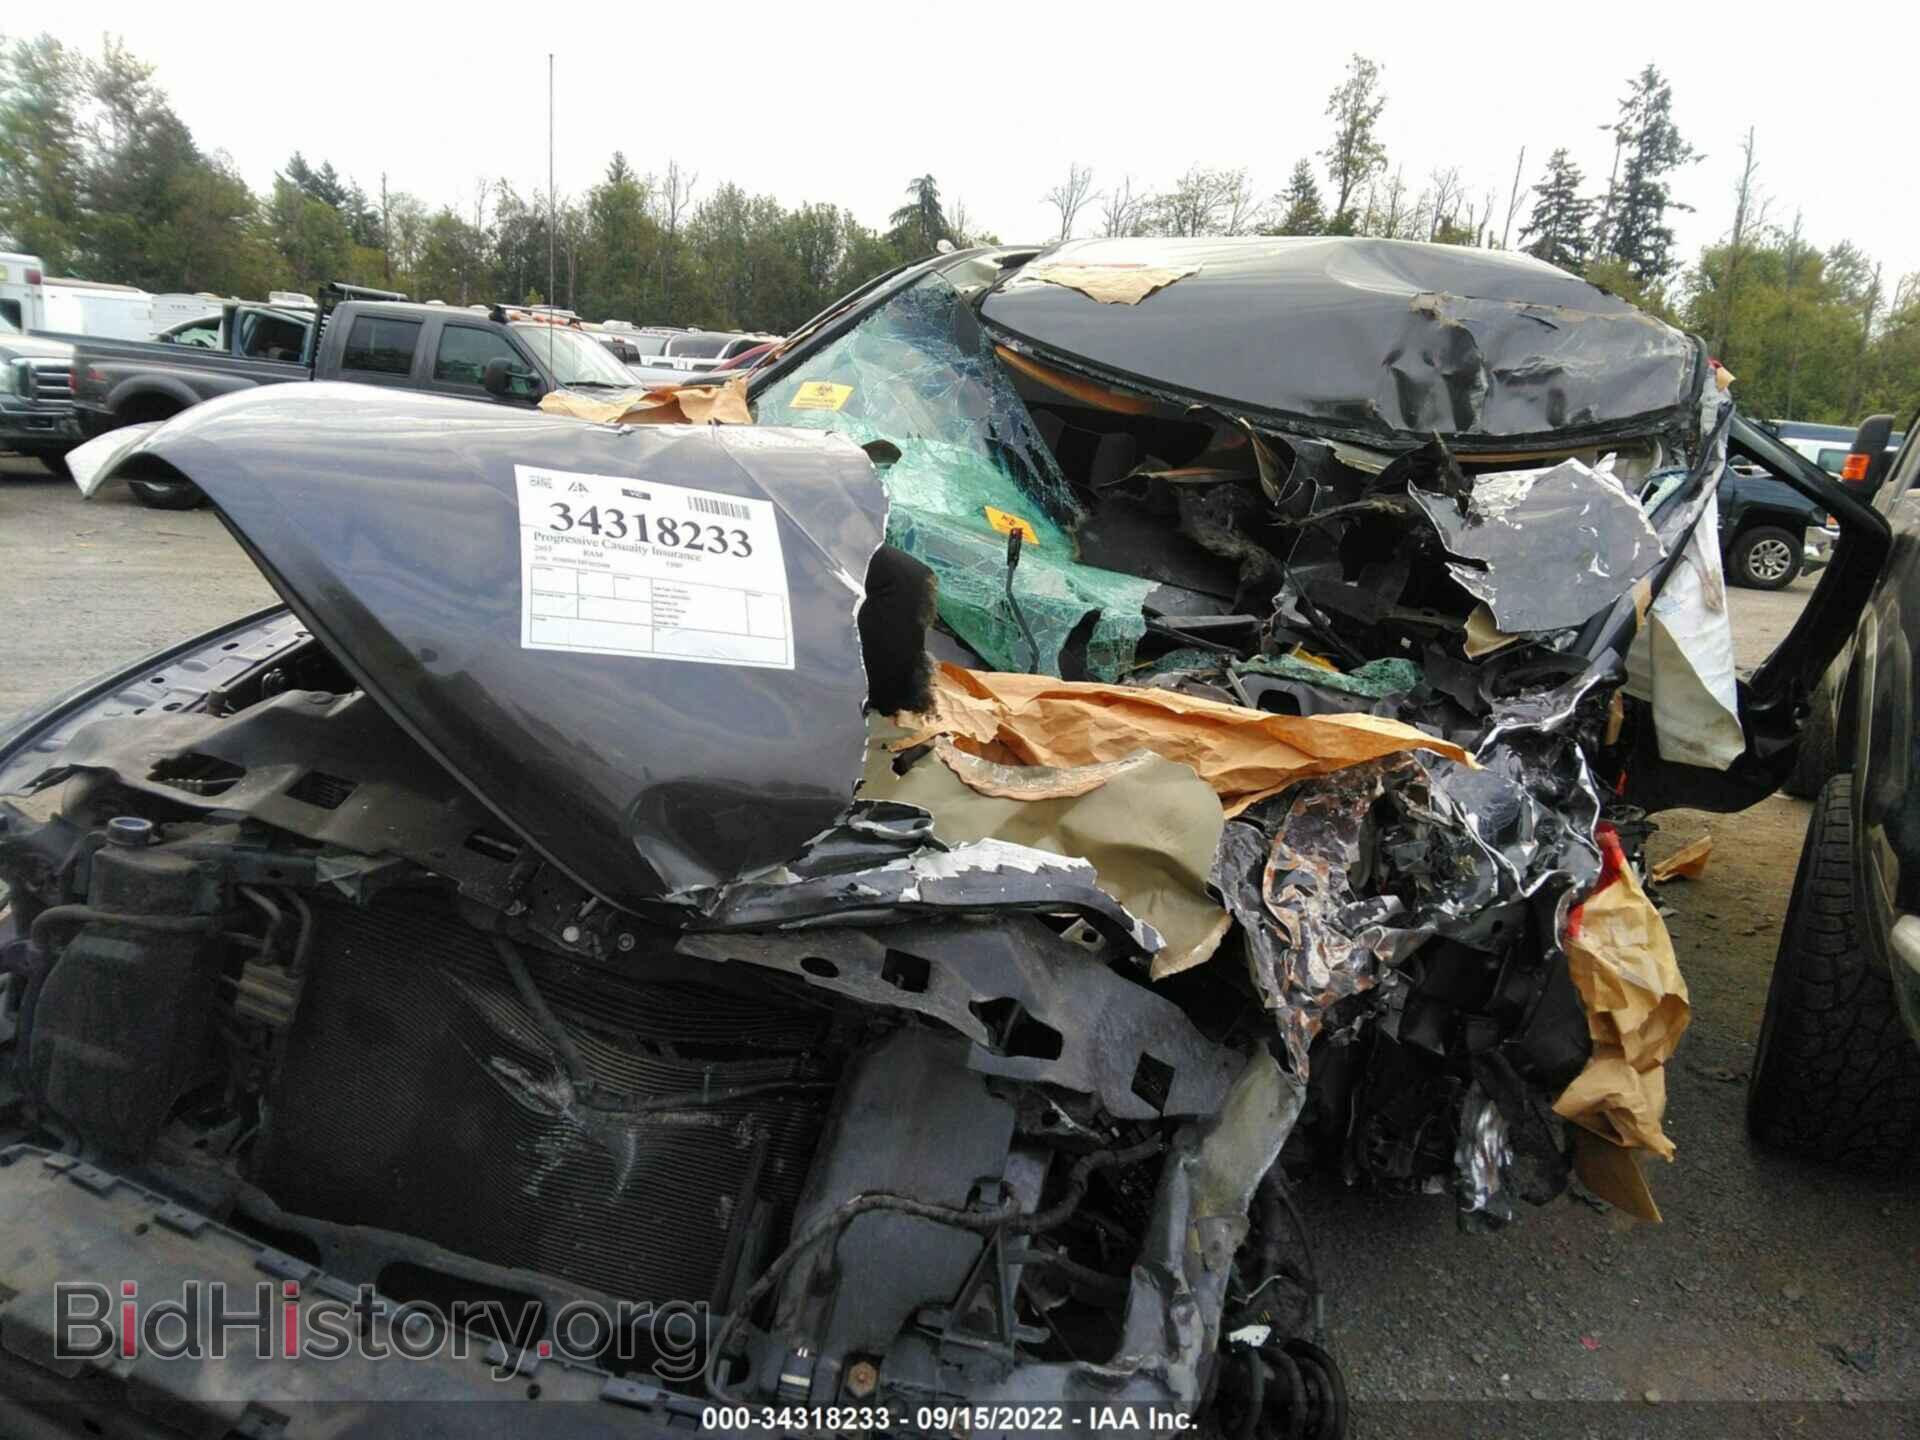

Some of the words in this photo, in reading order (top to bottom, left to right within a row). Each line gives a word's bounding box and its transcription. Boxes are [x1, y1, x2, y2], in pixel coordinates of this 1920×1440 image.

[534, 531, 600, 548] Progressive
[601, 539, 649, 557] Casualty
[651, 546, 703, 562] Insurance
[549, 502, 753, 558] 34318233
